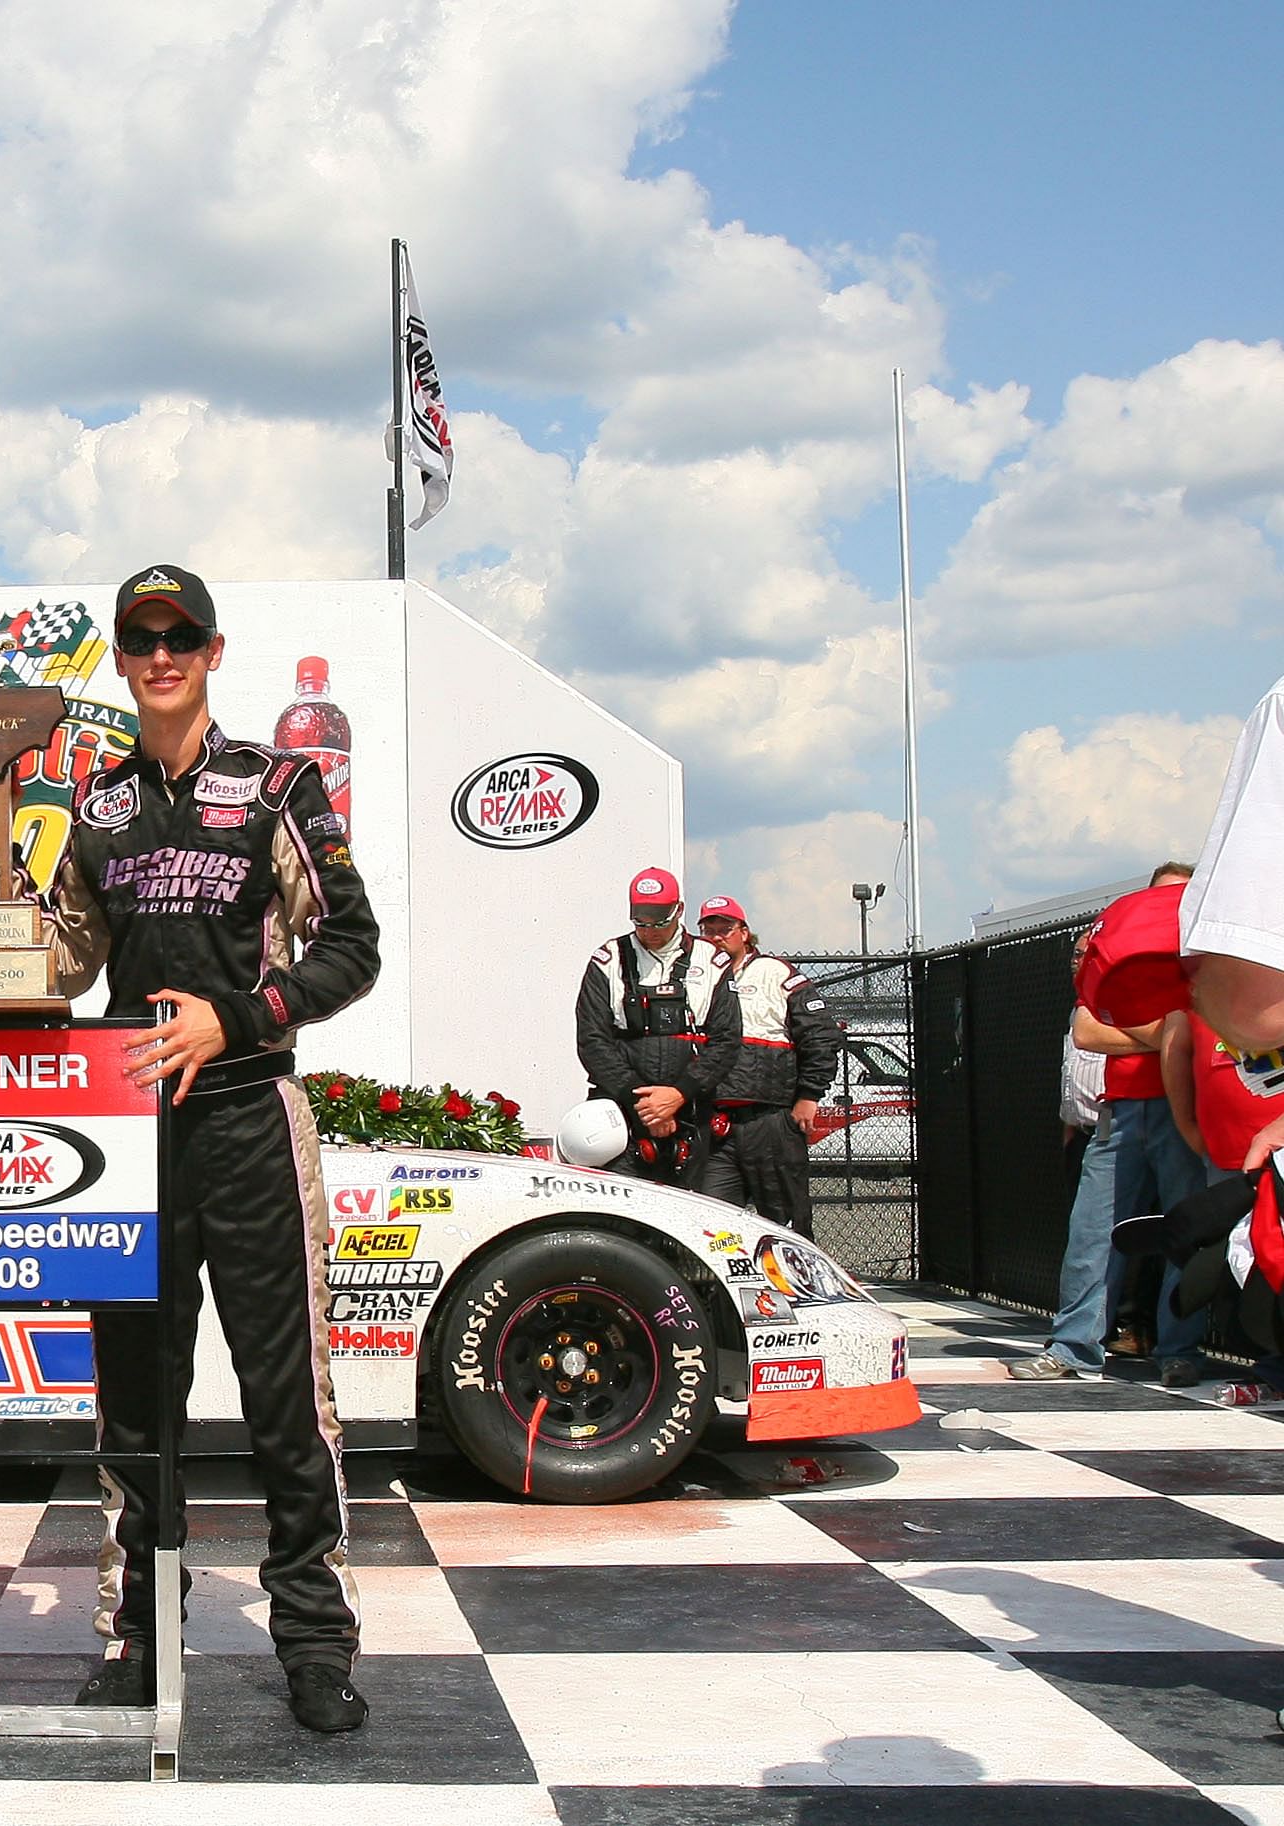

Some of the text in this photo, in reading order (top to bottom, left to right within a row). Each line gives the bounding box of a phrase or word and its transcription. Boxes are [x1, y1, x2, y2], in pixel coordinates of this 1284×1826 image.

[486, 767, 530, 794] ARCA
[480, 788, 567, 826] RE/MAX
[502, 821, 559, 836] SERIES
[136, 877, 241, 903] DRIVEN
[136, 901, 195, 914] ACING
[0, 969, 25, 980] 500
[404, 1188, 452, 1209] RSS
[526, 1174, 634, 1199] Hoosier
[334, 1188, 376, 1214] CV
[329, 1262, 440, 1286] MOROSO
[664, 1285, 693, 1316] SET
[654, 1307, 679, 1330] RF
[329, 1326, 414, 1356] Holley
[450, 1279, 509, 1392] Hoosier
[752, 1331, 821, 1349] COMETIC
[759, 1365, 821, 1388] Mallory
[650, 1343, 707, 1456] Hoosier
